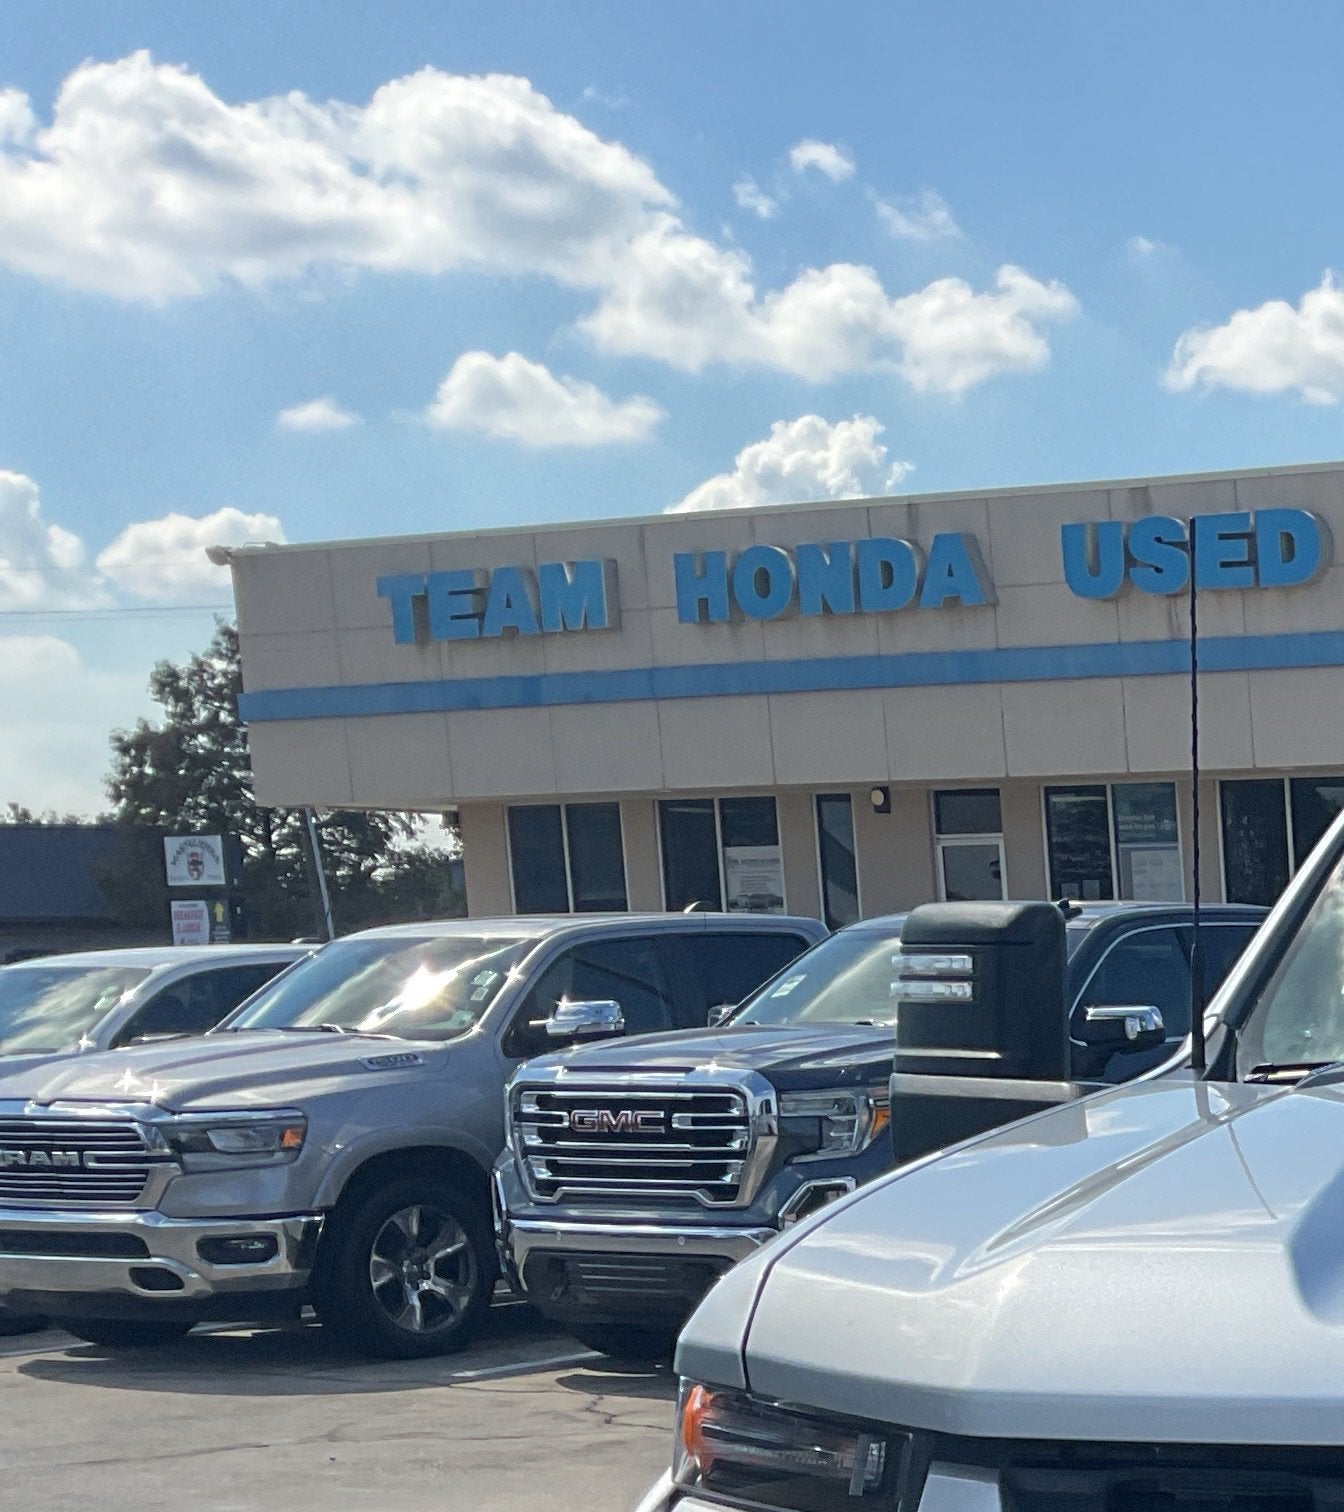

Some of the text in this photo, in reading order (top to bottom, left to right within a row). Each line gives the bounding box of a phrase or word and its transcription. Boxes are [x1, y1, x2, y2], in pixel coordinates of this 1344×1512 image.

[377, 559, 608, 644] TEAM
[674, 532, 985, 624] HONDA
[1061, 508, 1324, 600] USED
[570, 1109, 665, 1133] GMC
[0, 1150, 80, 1167] RAM
